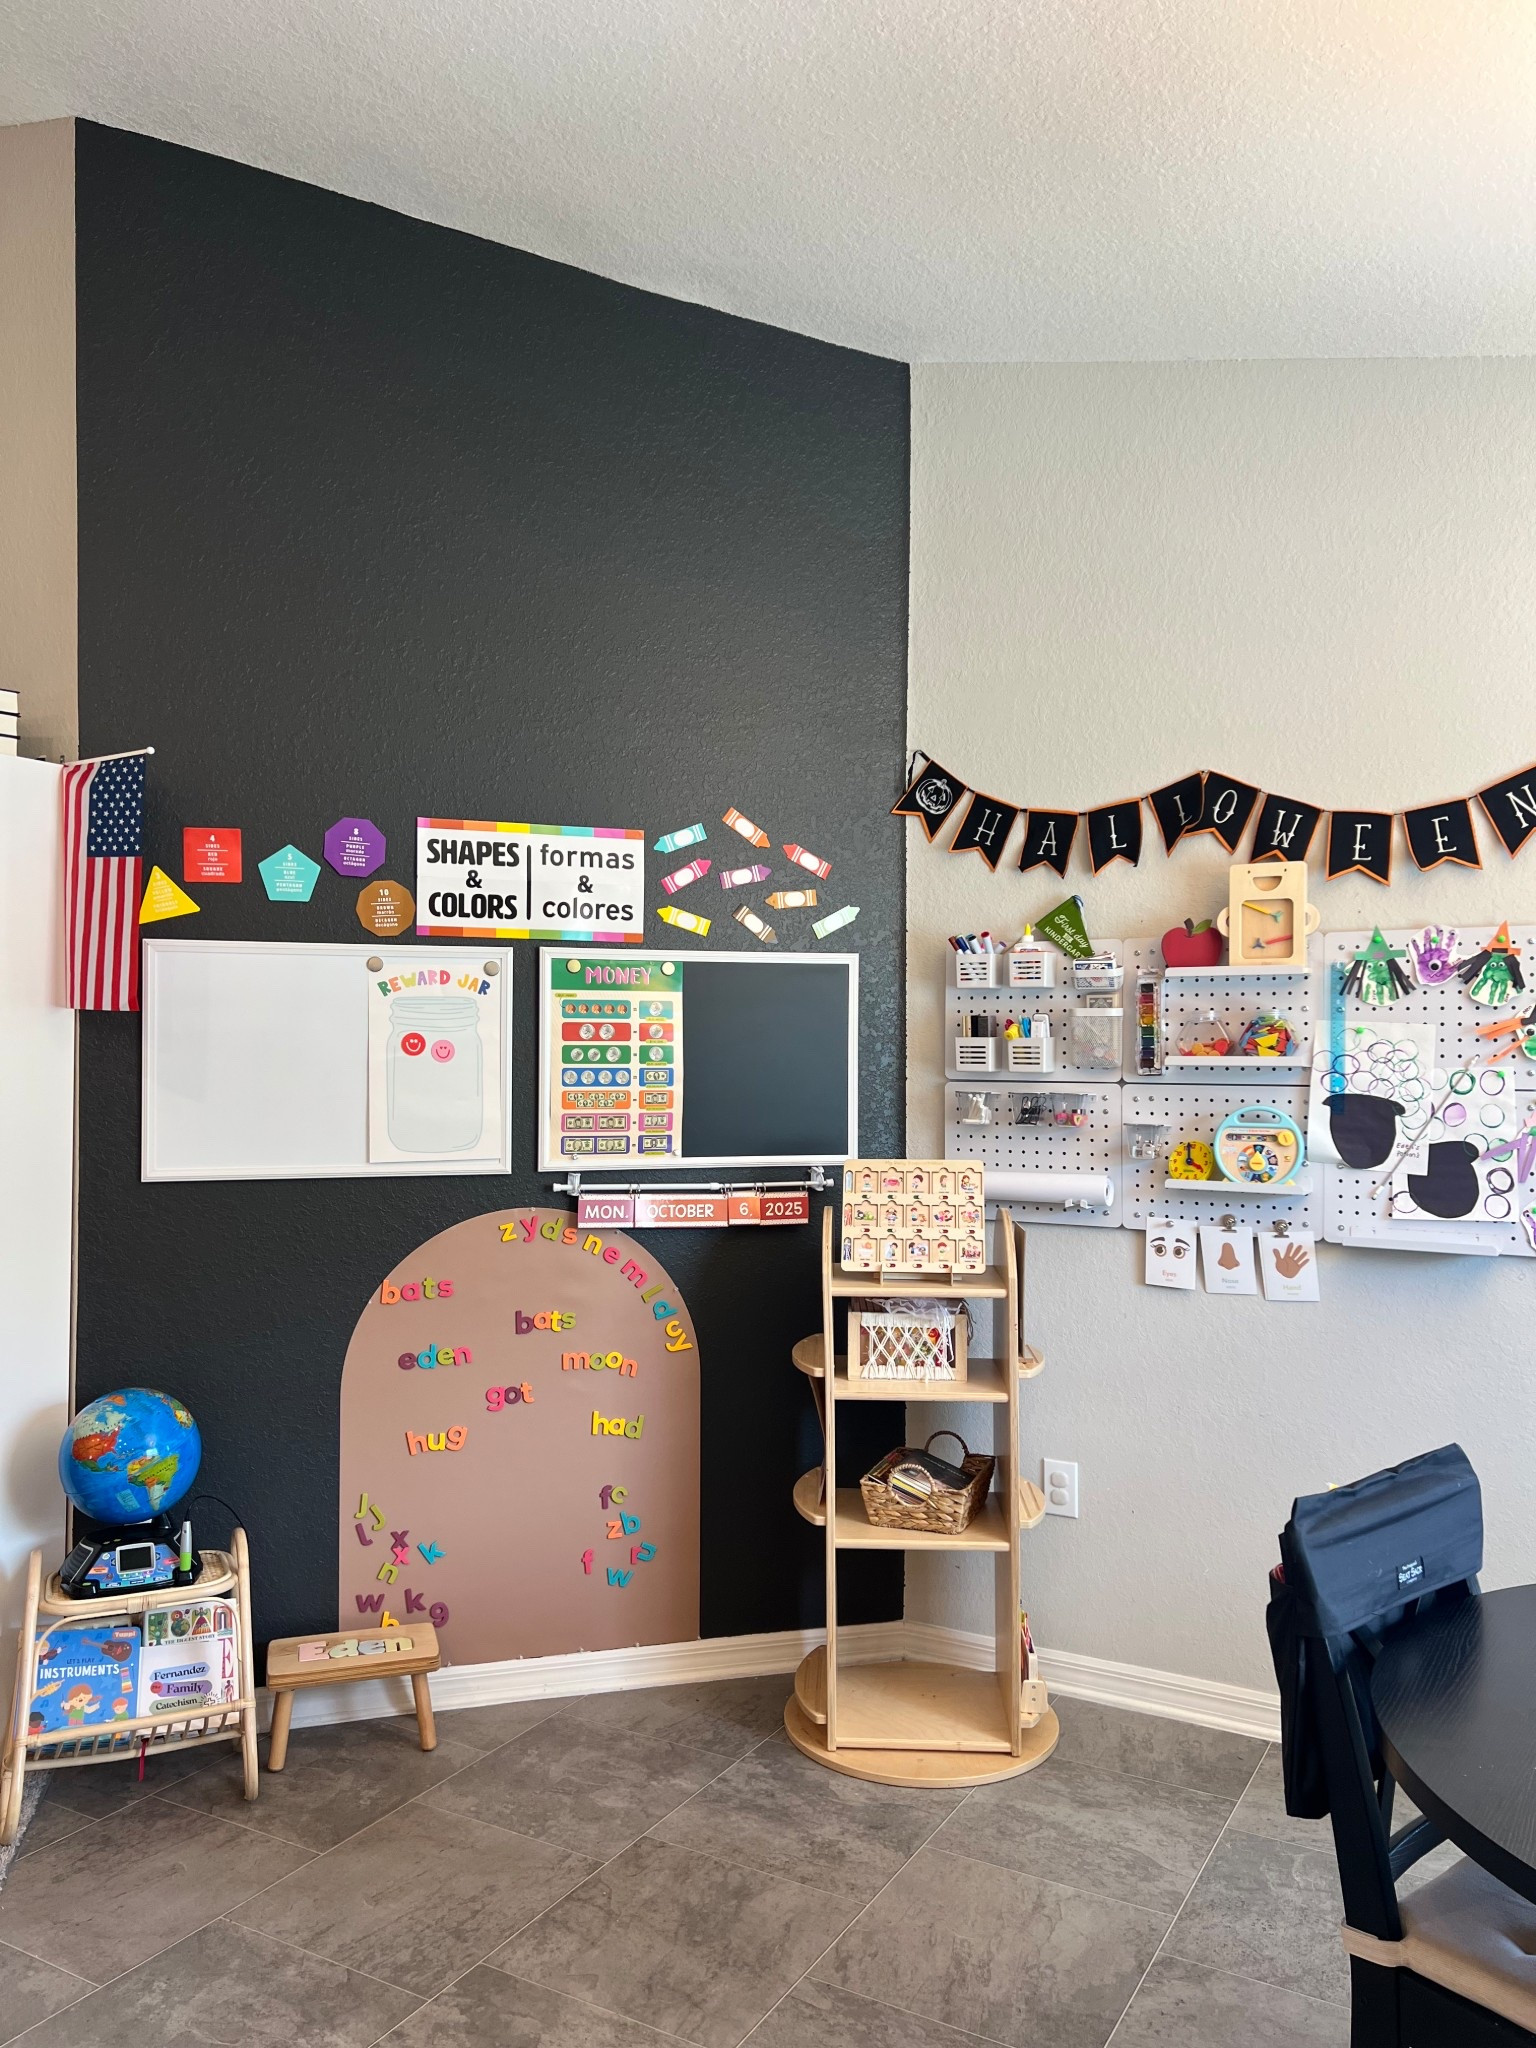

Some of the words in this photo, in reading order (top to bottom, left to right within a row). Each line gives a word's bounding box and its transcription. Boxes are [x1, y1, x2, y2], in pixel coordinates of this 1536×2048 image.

[426, 838, 520, 867] SHAPES
[540, 844, 634, 870] formas
[466, 870, 482, 888] &
[578, 875, 594, 893] &
[428, 892, 518, 920] COLORS
[542, 897, 634, 921] colores
[1054, 914, 1076, 936] First
[1074, 934, 1089, 948] day
[377, 970, 450, 997] REWARD
[457, 974, 490, 995] JAR
[585, 966, 652, 985] MONEY
[584, 1204, 629, 1219] MON.
[646, 1203, 714, 1219] OCTOBER
[765, 1202, 803, 1216] 2025
[380, 1277, 454, 1304] bats
[515, 1310, 576, 1335] bats
[398, 1343, 472, 1370] eden
[561, 1351, 638, 1378] moon
[486, 1382, 535, 1412] got
[591, 1410, 645, 1439] had
[406, 1425, 468, 1456] hug
[298, 1637, 413, 1662] Eden
[40, 1664, 120, 1679] INSTRUMENTS
[154, 1666, 206, 1680] Fernandez
[167, 1682, 204, 1693] Family
[156, 1698, 198, 1710] Catechism
